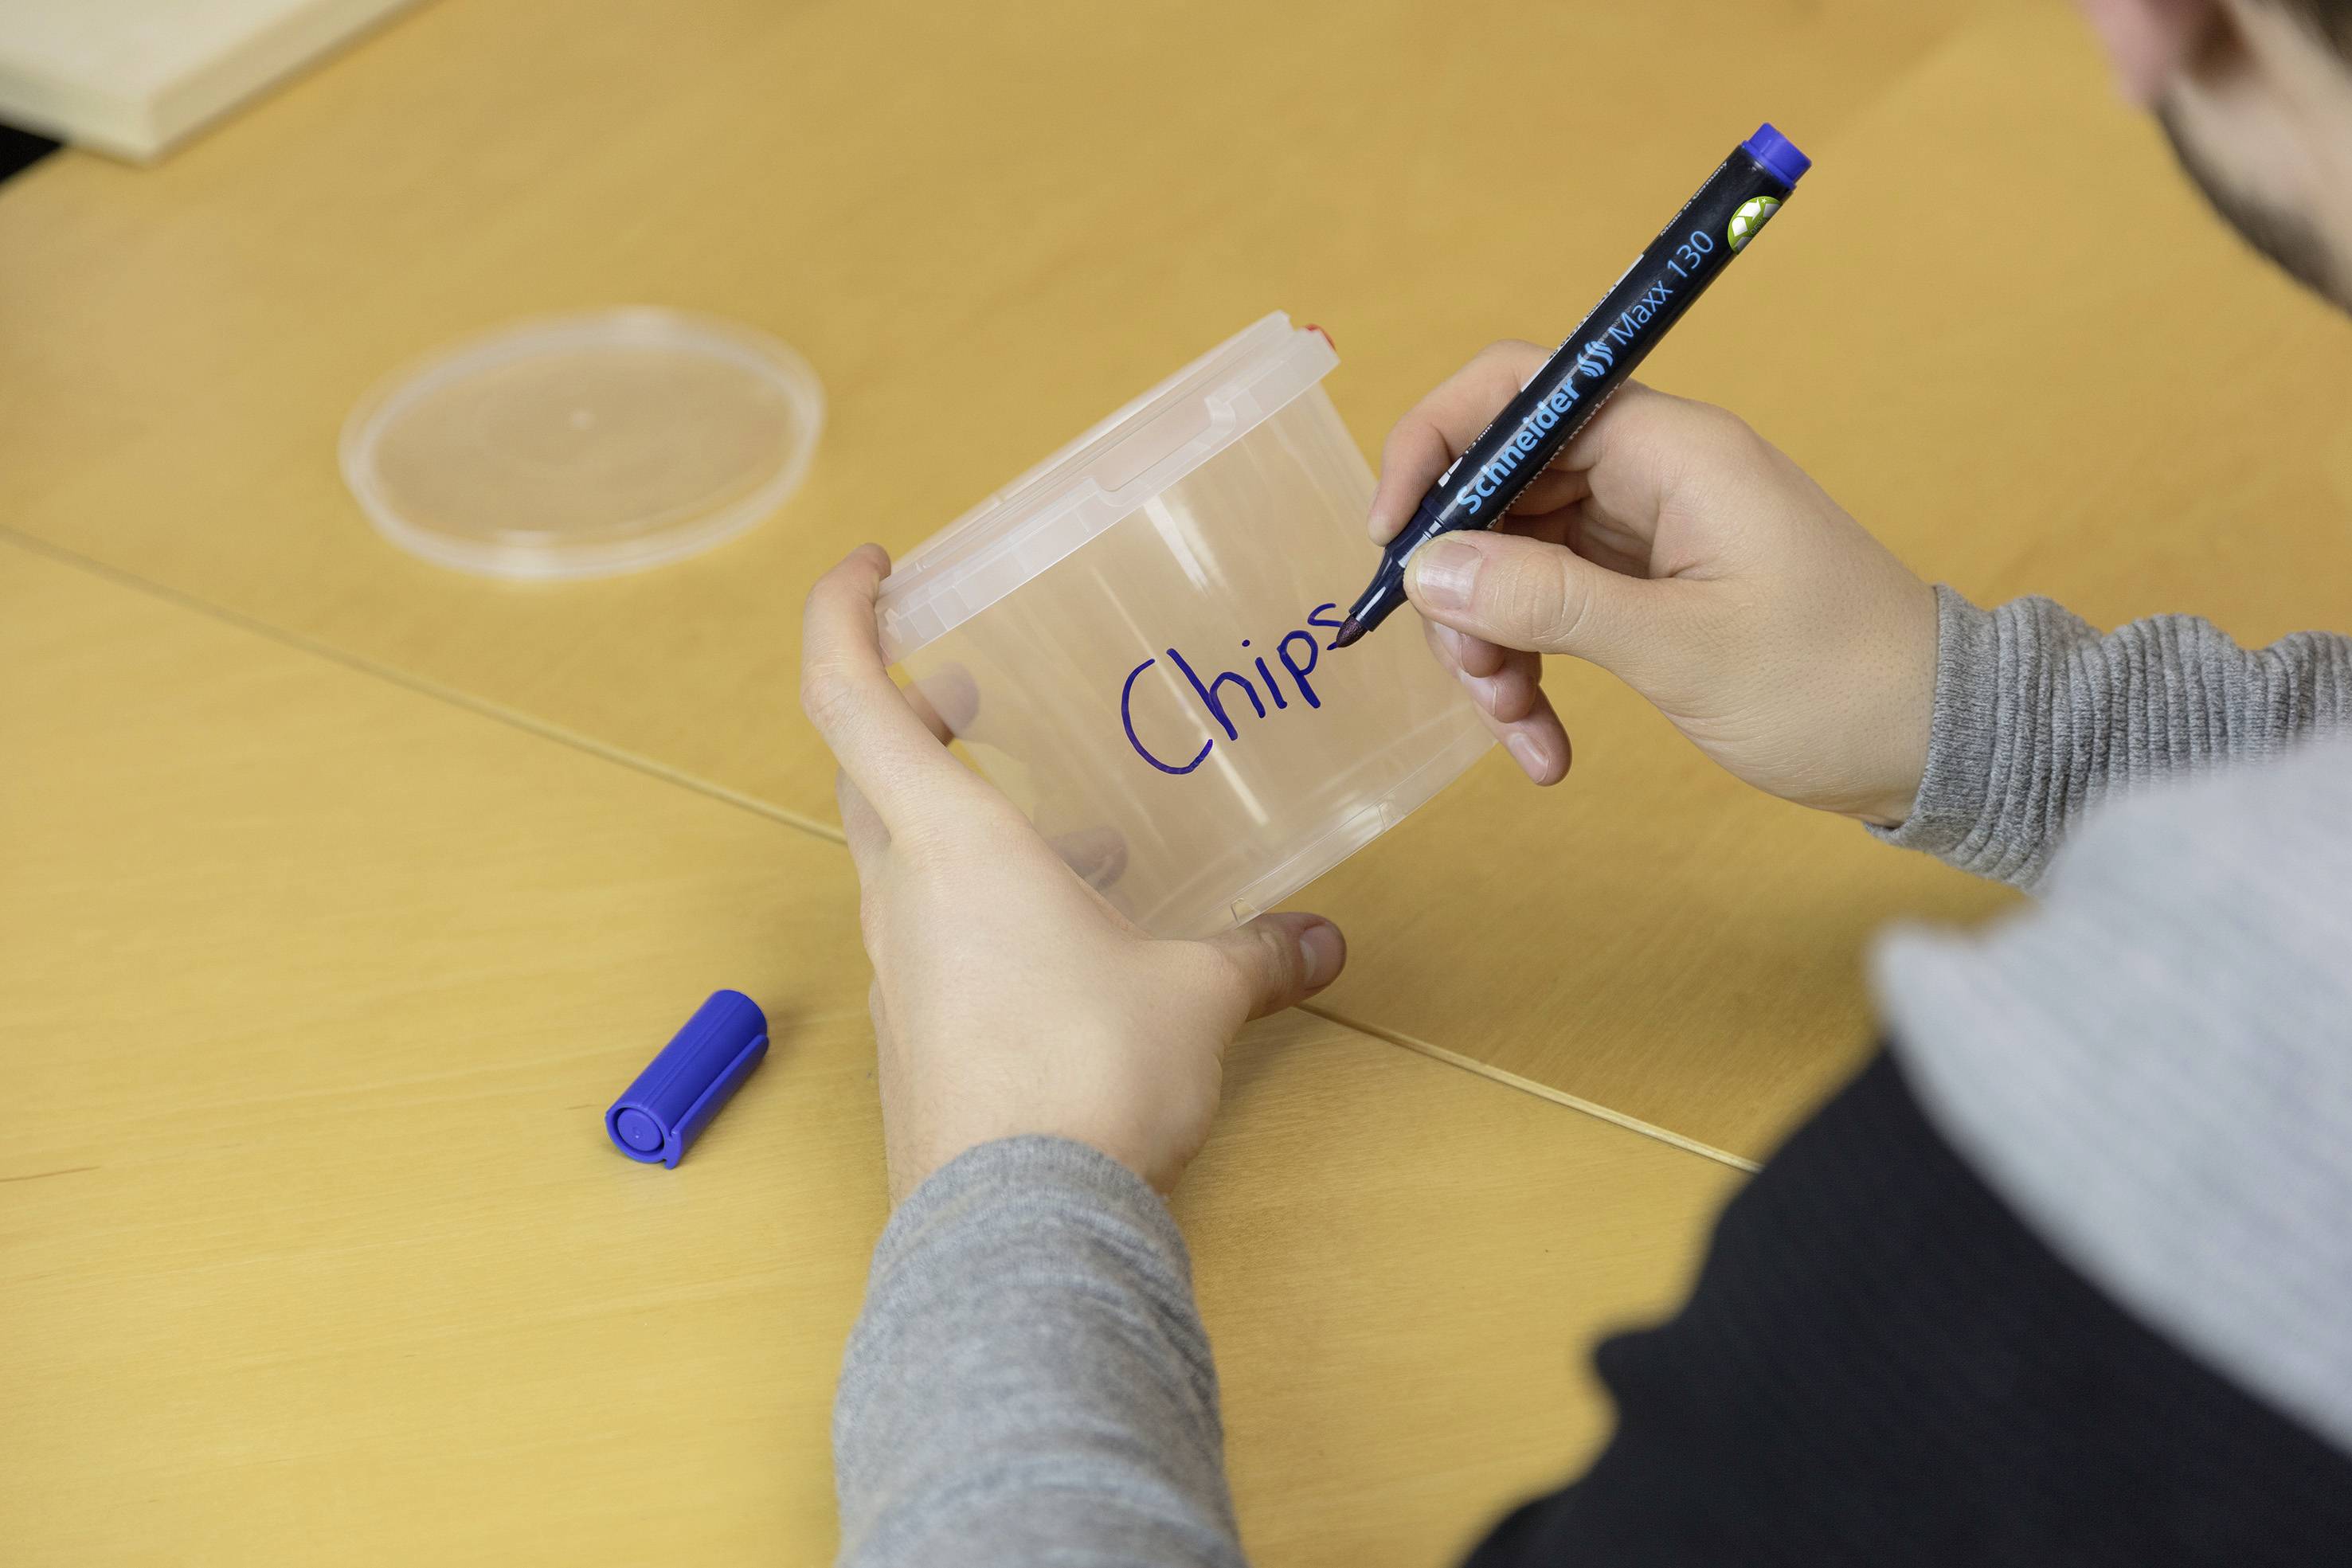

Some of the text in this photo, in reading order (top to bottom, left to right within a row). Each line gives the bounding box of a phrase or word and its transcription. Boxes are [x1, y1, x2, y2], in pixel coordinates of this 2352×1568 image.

[1456, 230, 1714, 514] Schneider Maxx 130
[1121, 603, 1344, 775] Chips
